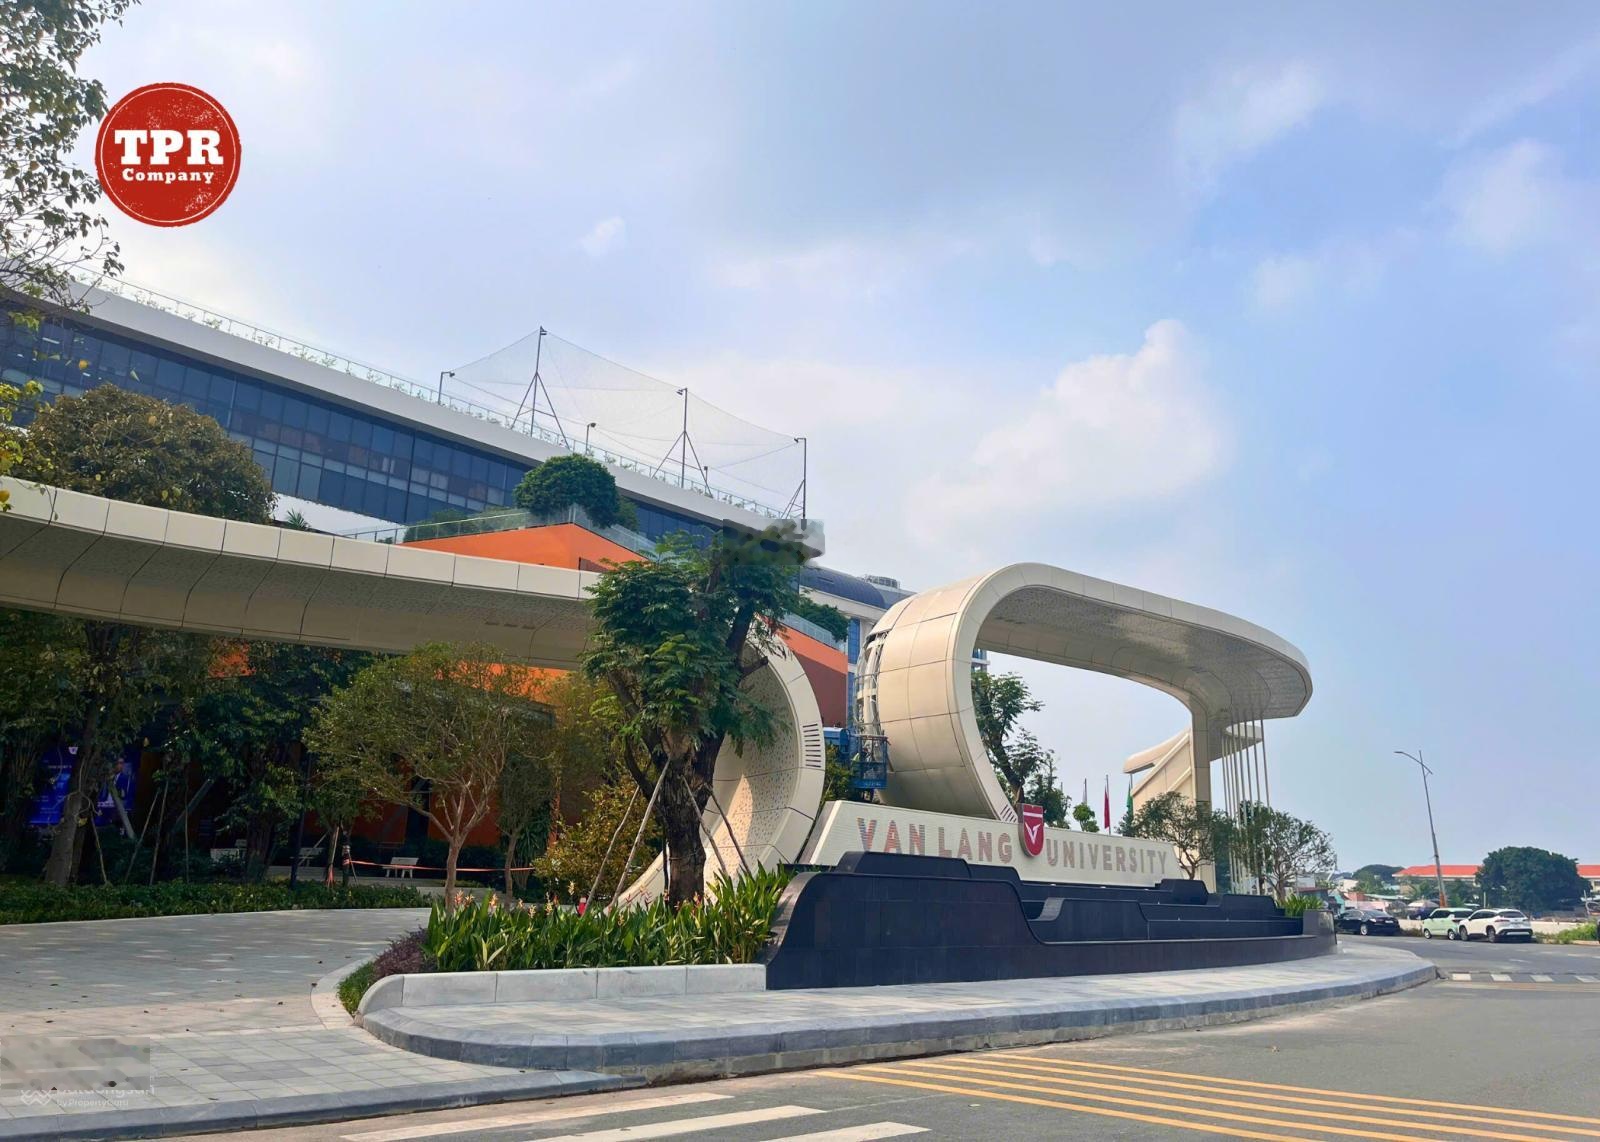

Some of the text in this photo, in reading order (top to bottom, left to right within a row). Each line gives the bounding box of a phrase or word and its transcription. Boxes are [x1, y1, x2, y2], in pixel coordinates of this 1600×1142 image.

[857, 817, 1167, 875] VAN LANG UNIVERSITY
